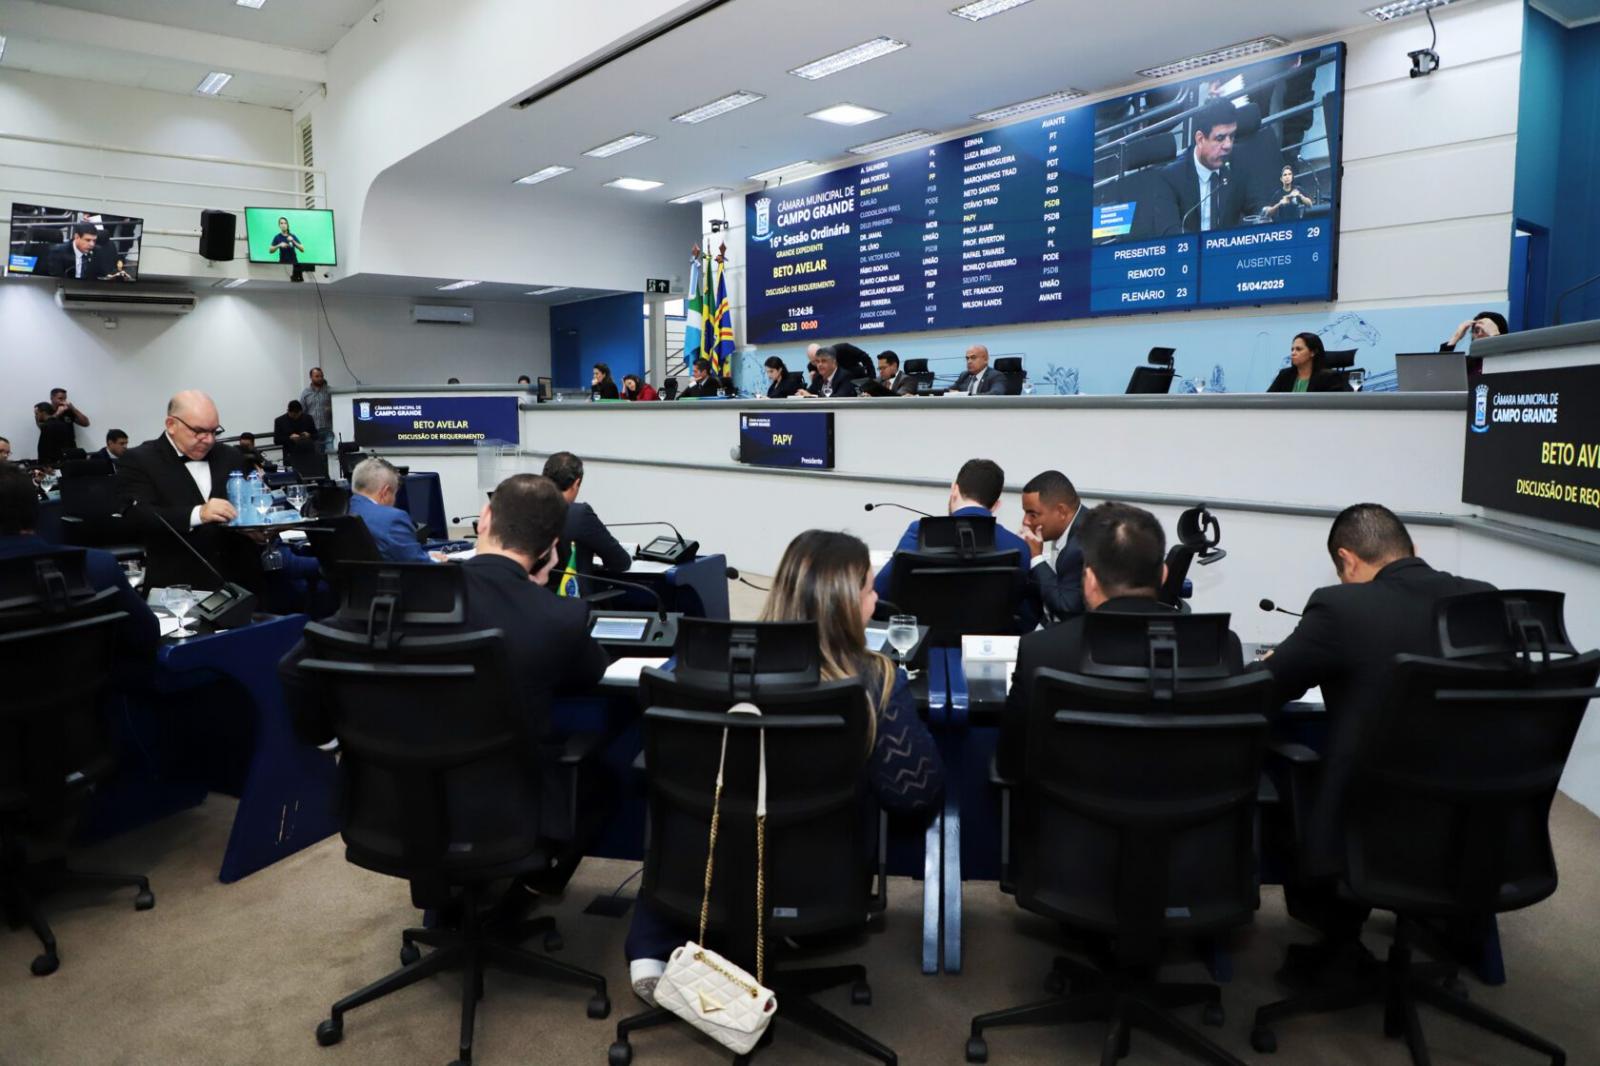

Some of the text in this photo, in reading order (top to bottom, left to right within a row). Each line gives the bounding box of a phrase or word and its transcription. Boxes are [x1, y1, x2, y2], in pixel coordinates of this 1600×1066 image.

[1042, 116, 1066, 128] AVANTE
[1049, 132, 1057, 140] PT
[1049, 145, 1057, 153] PP
[964, 151, 979, 160] LUIZA
[964, 155, 1016, 172] MAICON NOGUEIRA
[1046, 158, 1058, 167] PDT
[860, 176, 870, 185] ANA
[964, 168, 1017, 184] MARQUINHOS TRAD
[1046, 172, 1058, 180] REP
[860, 184, 889, 196] BETO AVELAR
[964, 184, 1000, 197] NETO SANTOS
[1046, 186, 1058, 194] PSD
[778, 186, 854, 213] CÂMARA MUNICIPAL DE
[984, 197, 998, 206] TRAD
[1044, 198, 1060, 208] PSDB
[777, 199, 854, 227] CAMPO GRANDE
[964, 214, 976, 222] PAPY
[1044, 212, 1060, 221] PSDB
[770, 222, 850, 248] 16ª Sessão Ordinária
[963, 226, 977, 234] PROF.
[1048, 226, 1056, 234] PP
[868, 232, 882, 240] JAMAL
[922, 232, 939, 241] UNIÃO
[963, 234, 1004, 246] PROF. RIVERTON
[1206, 226, 1320, 249] PARLAMENTARES 29
[776, 243, 824, 258] GRANDE EXPEDIENTE
[884, 251, 900, 259] ROCHA
[963, 247, 1004, 259] RAFAEL TAVARES
[1114, 242, 1188, 260] PRESENTES 23
[922, 256, 938, 266] UNIÃO
[1043, 252, 1059, 261] PODE
[1236, 252, 1319, 270] AUSENTES 6
[873, 264, 888, 272] ROCHA
[986, 258, 1017, 268] GUERREIRO
[773, 259, 827, 278] BETO AVELAR
[1043, 266, 1058, 274] PSDB
[1128, 264, 1188, 280] REMOTO 0
[766, 284, 790, 296] DISCUSSÃO
[798, 280, 836, 292] REQUERIMENTO
[1040, 278, 1060, 288] UNIÃO
[1236, 279, 1284, 292] 15/04/2025
[974, 286, 1004, 295] FRANCISCO
[1122, 288, 1188, 302] PLENÁRIO 23
[1038, 292, 1062, 302] AVANTE
[962, 298, 1002, 308] WILSON LANDS
[800, 320, 818, 330] 00:00
[860, 321, 884, 330] LANDMARK
[1492, 392, 1560, 406] CÂMARA MUNICIPAL DE
[1492, 408, 1558, 424] CAMPO GRANDE
[414, 420, 468, 429] BETO AVELAR
[772, 434, 792, 446] PAPY
[1541, 442, 1574, 466] BETO
[801, 456, 823, 464] Presidente
[1516, 478, 1562, 500] DISCUSSÃO
[1564, 486, 1577, 503] DE
